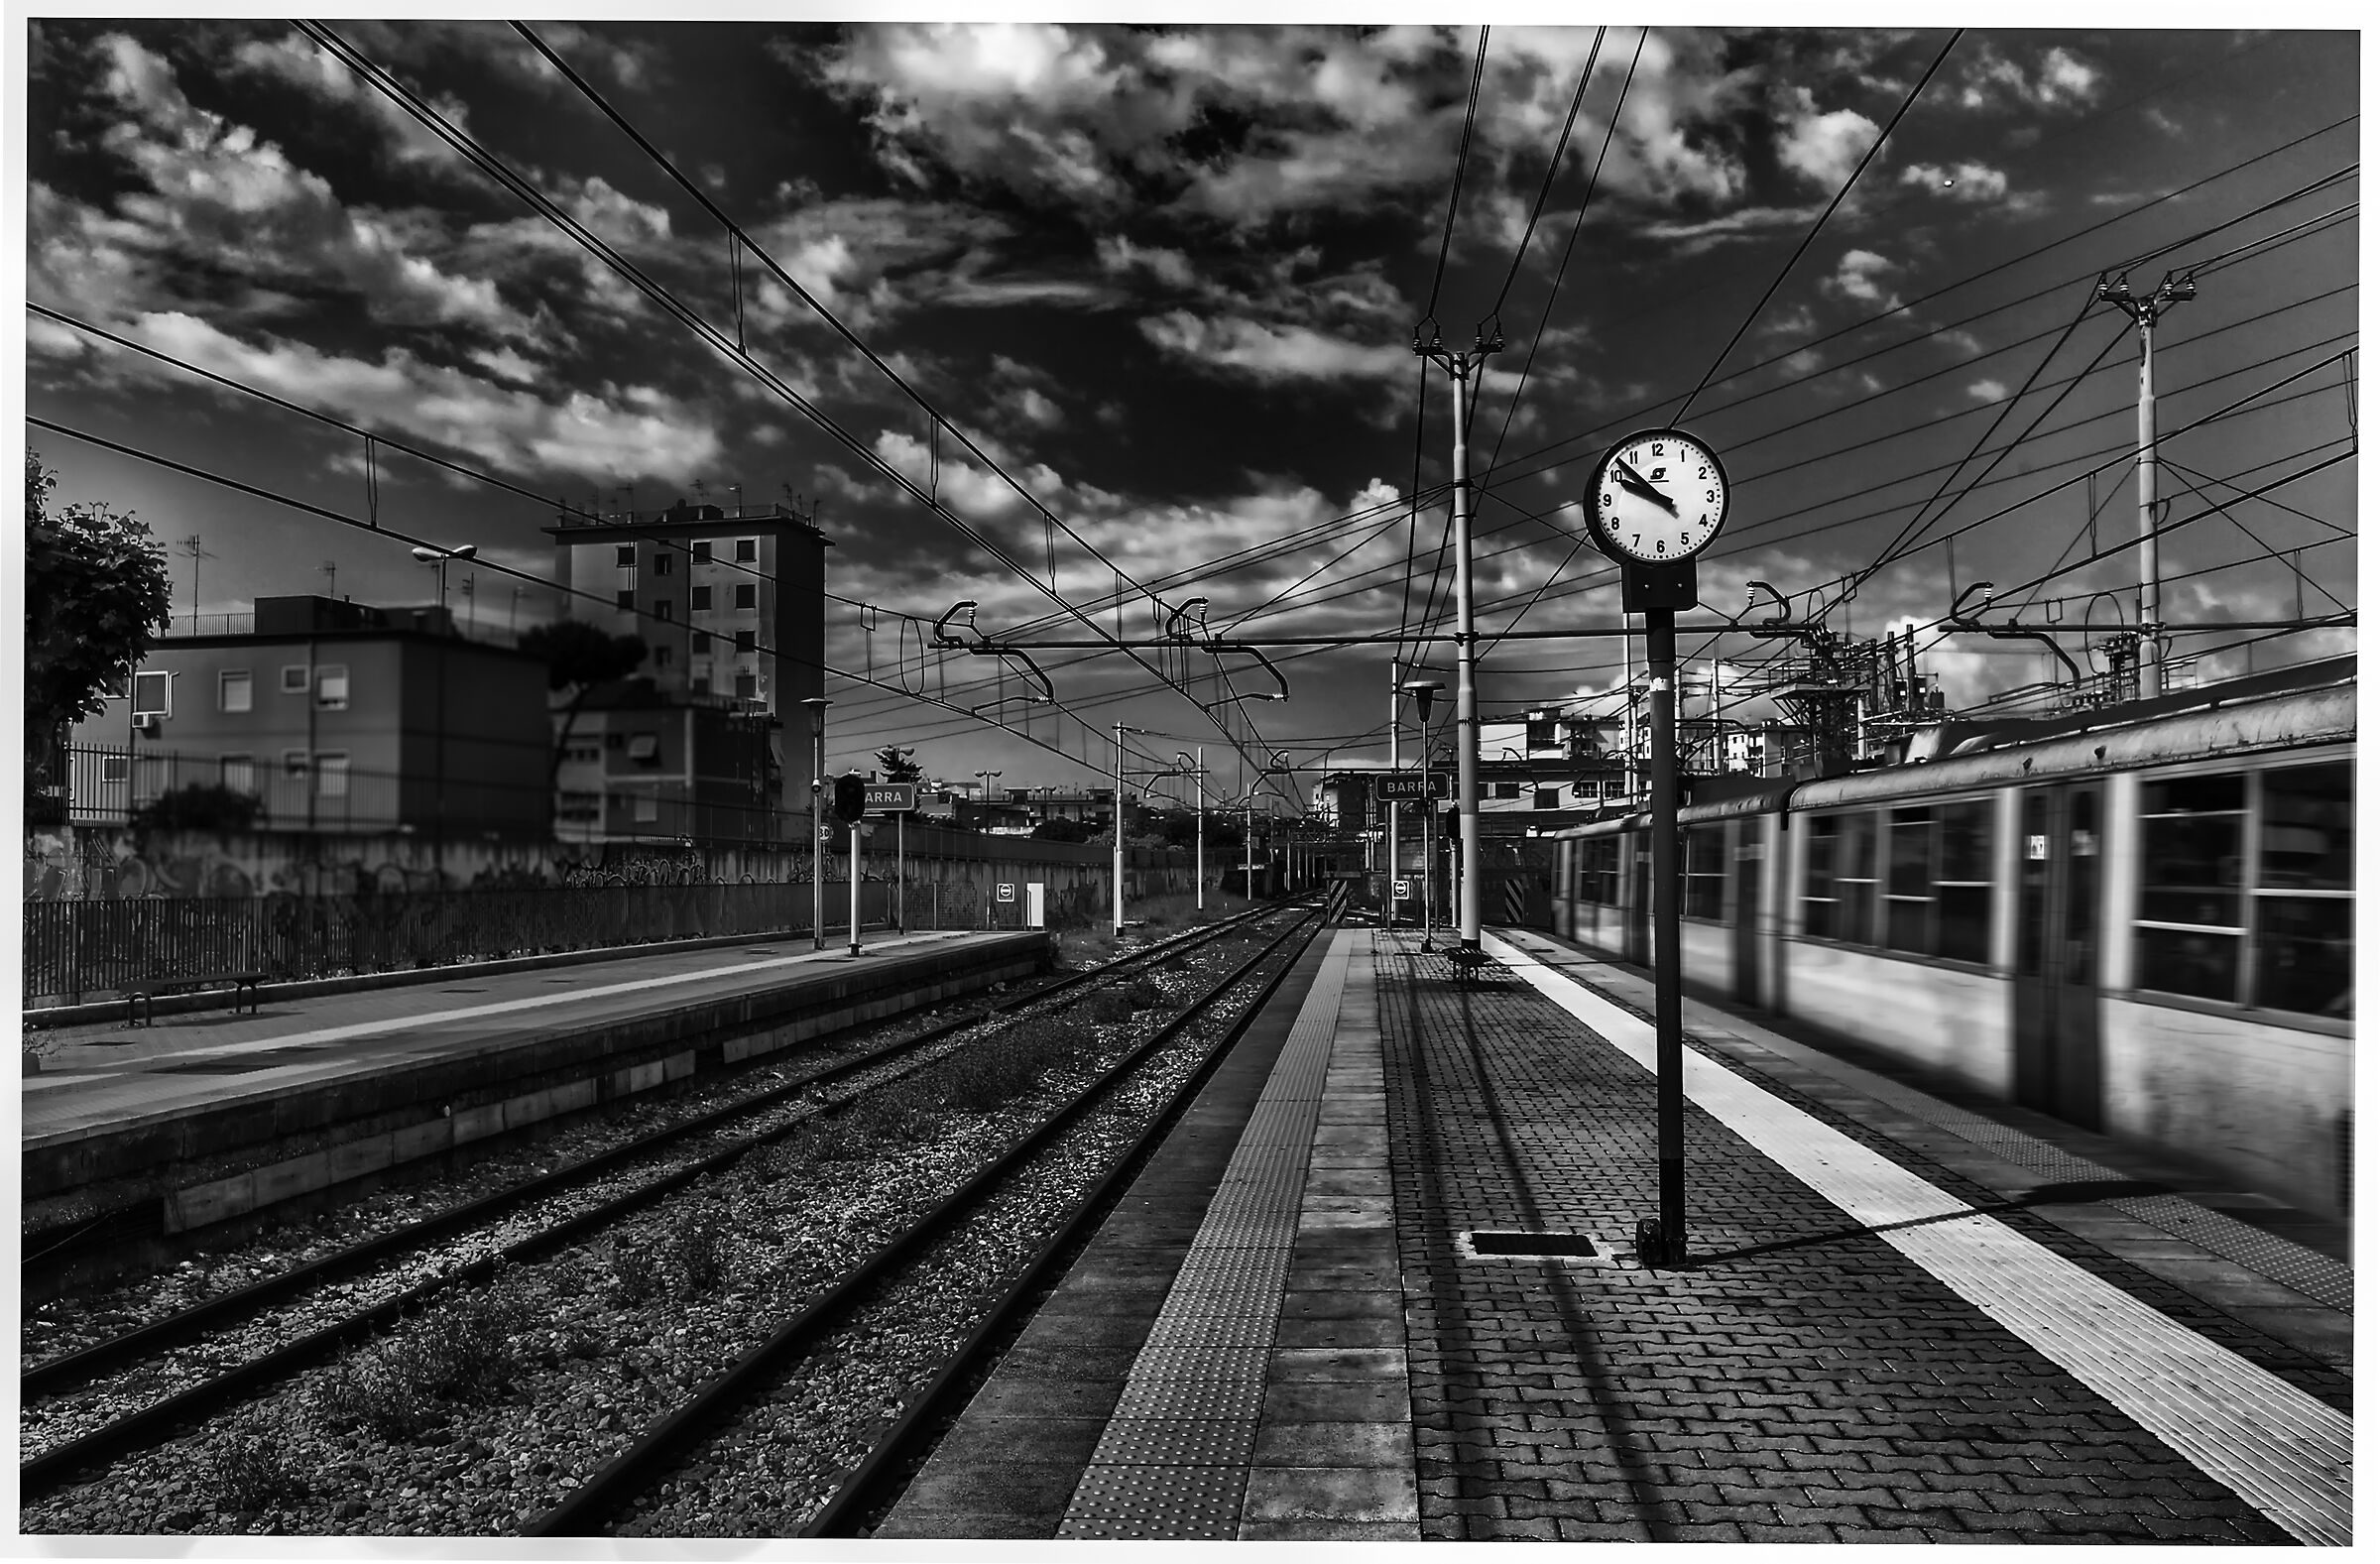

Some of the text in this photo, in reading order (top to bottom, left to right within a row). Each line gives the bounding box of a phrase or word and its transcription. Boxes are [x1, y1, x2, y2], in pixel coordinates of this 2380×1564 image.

[1651, 443, 1664, 456] 12
[1680, 449, 1685, 462] 1
[1629, 451, 1638, 464] 11
[1609, 470, 1622, 483] 10
[1699, 466, 1707, 479] 2
[1603, 494, 1611, 507] 9
[1707, 490, 1715, 503] 3
[1610, 517, 1619, 531] 8
[1699, 514, 1708, 527] 4
[1631, 535, 1641, 547] 7
[1680, 533, 1690, 545] 5
[1656, 541, 1665, 553] 6
[865, 792, 902, 802] ARRA
